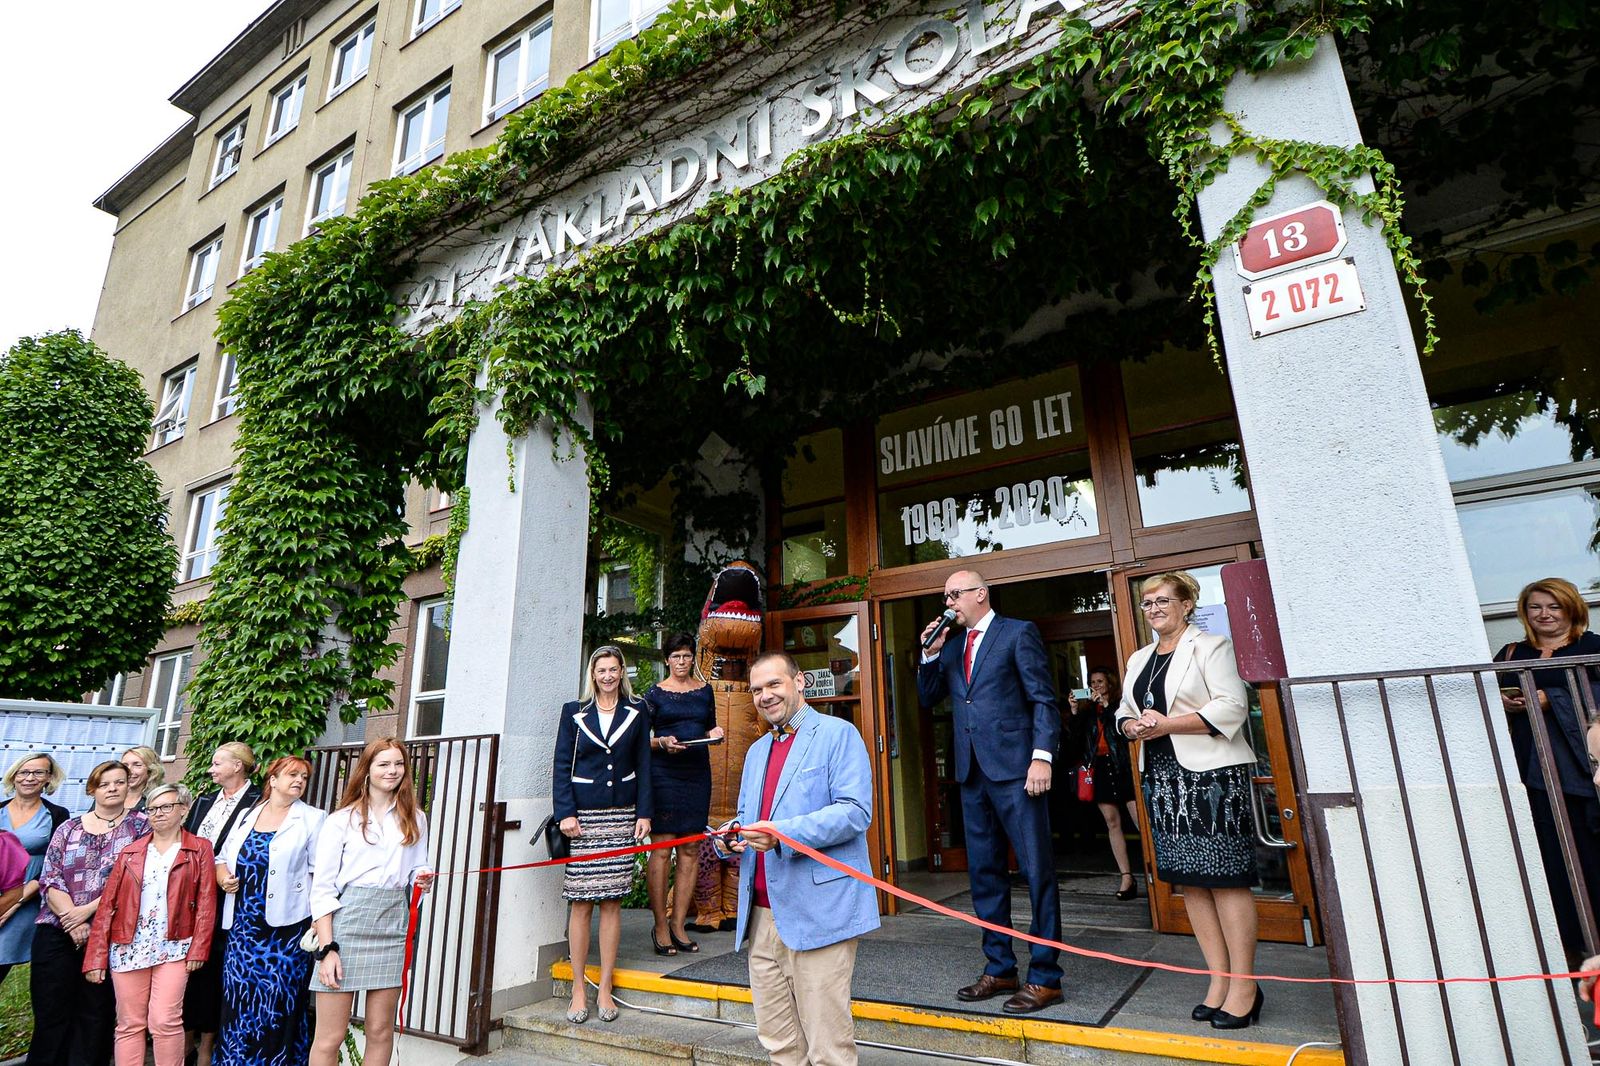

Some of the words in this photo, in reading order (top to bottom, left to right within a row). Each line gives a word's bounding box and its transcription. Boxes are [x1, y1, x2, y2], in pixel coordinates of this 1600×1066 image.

[490, 88, 772, 286] ZÁKLADNÍ
[1262, 221, 1308, 260] 13
[880, 415, 981, 475] SLAVÍME
[989, 404, 1024, 450] 60
[1032, 391, 1073, 440] LET
[901, 497, 960, 546] 1960
[995, 475, 1068, 530] 2020
